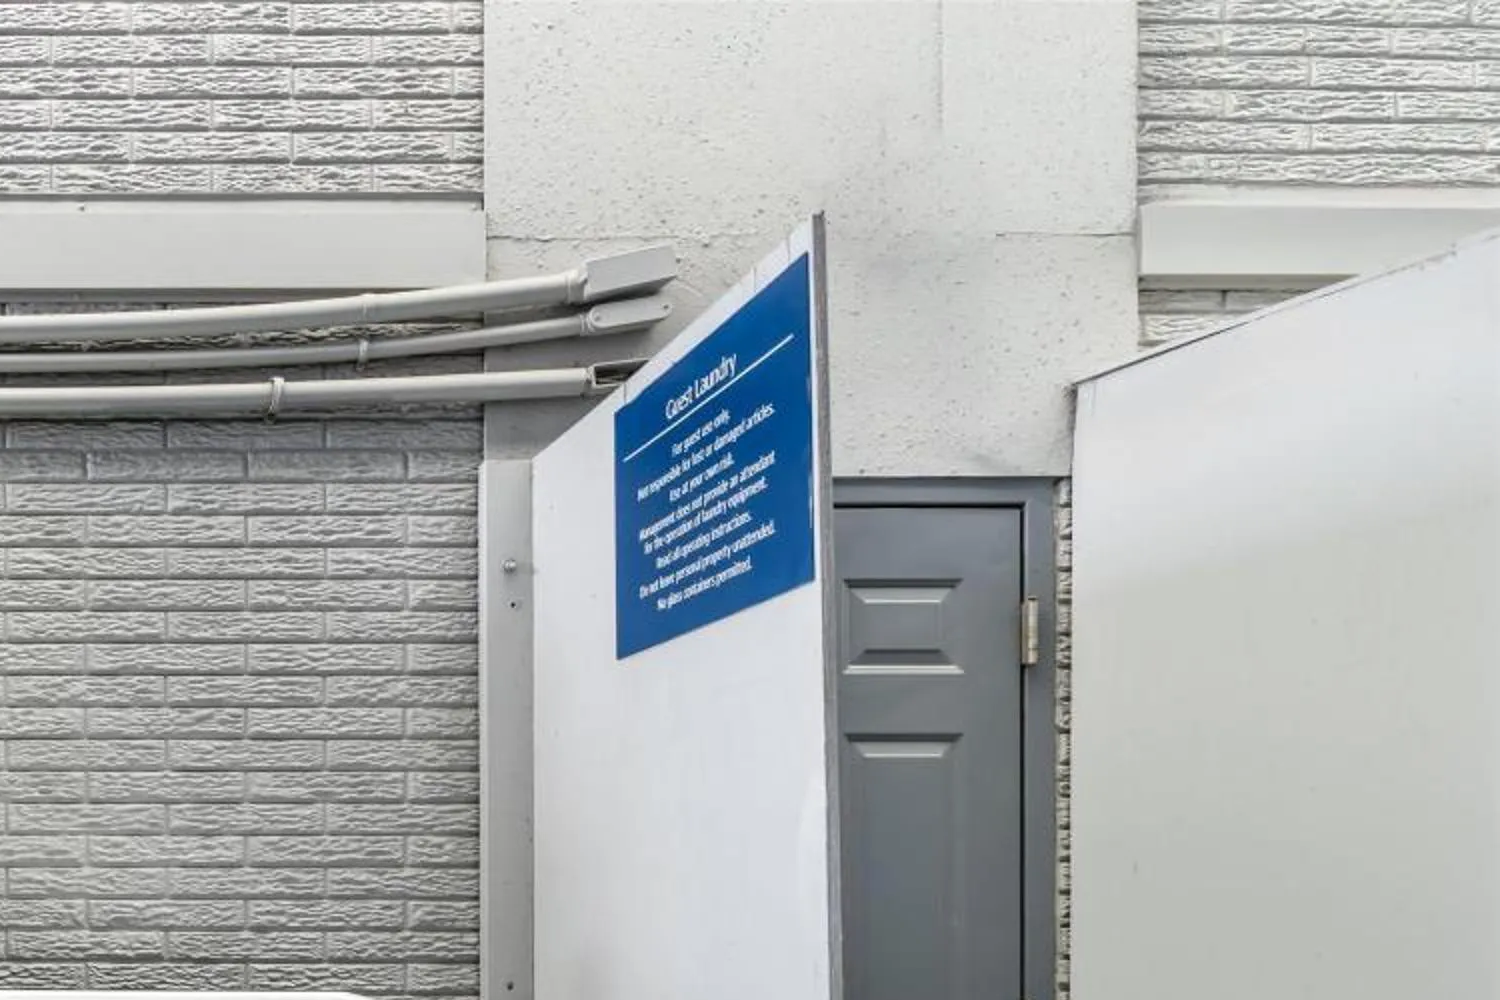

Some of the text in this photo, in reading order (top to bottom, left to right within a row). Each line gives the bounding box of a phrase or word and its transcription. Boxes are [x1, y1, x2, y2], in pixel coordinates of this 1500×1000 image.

[666, 355, 736, 418] Guest Laundry
[650, 466, 680, 492] responsible
[714, 419, 745, 450] damaged
[702, 502, 726, 521] laundry
[704, 481, 728, 505] provide
[676, 561, 701, 583] personal
[701, 546, 730, 568] property
